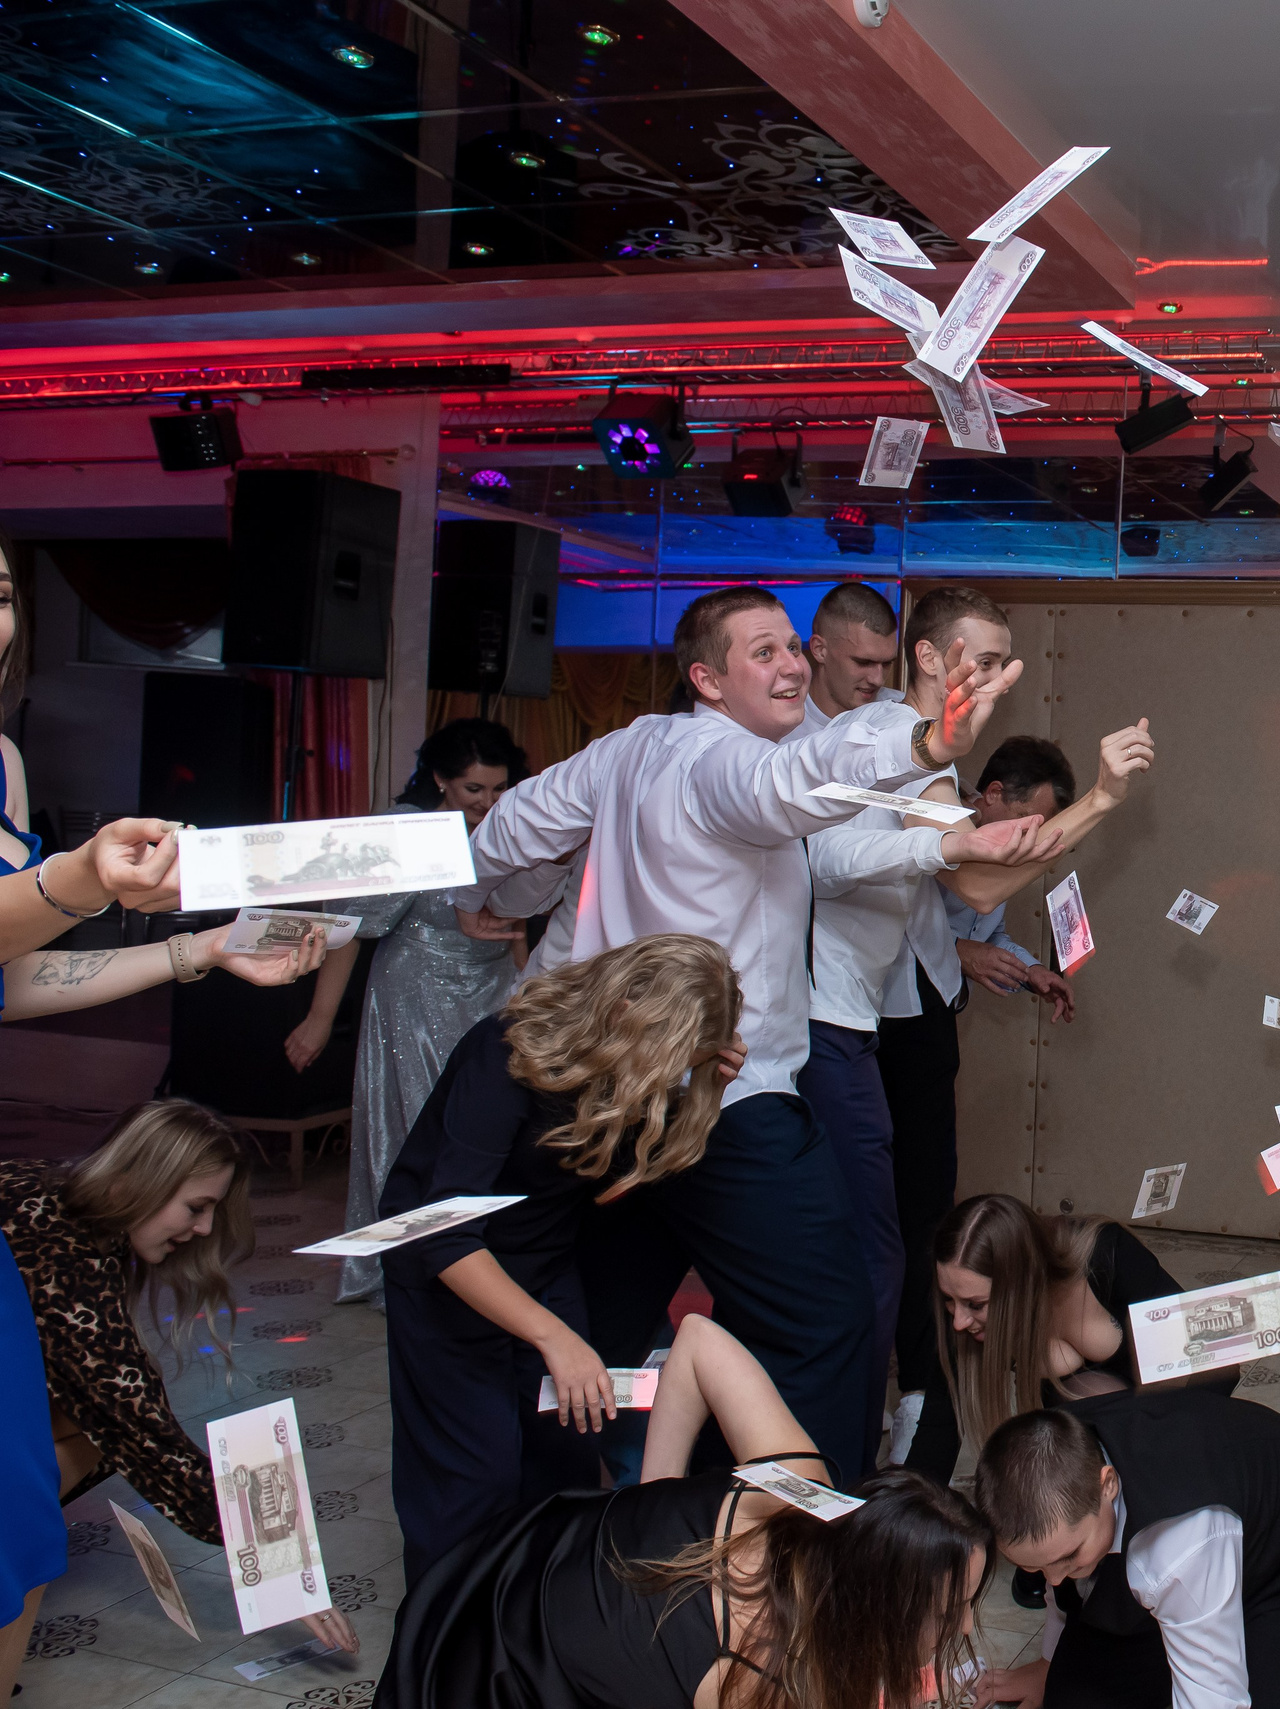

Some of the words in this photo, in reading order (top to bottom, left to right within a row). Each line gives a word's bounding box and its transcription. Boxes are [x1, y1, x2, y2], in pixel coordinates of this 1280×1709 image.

[1020, 251, 1036, 273] 500
[937, 317, 963, 350] 500
[954, 354, 969, 374] 500
[951, 406, 971, 436] 500
[242, 830, 285, 847] 100
[249, 913, 264, 921] 100
[335, 919, 351, 928] 100
[1148, 1308, 1170, 1321] 100
[615, 1394, 633, 1404] 00
[275, 1420, 289, 1444] 100
[236, 1543, 262, 1587] 100
[302, 1569, 317, 1593] 100
